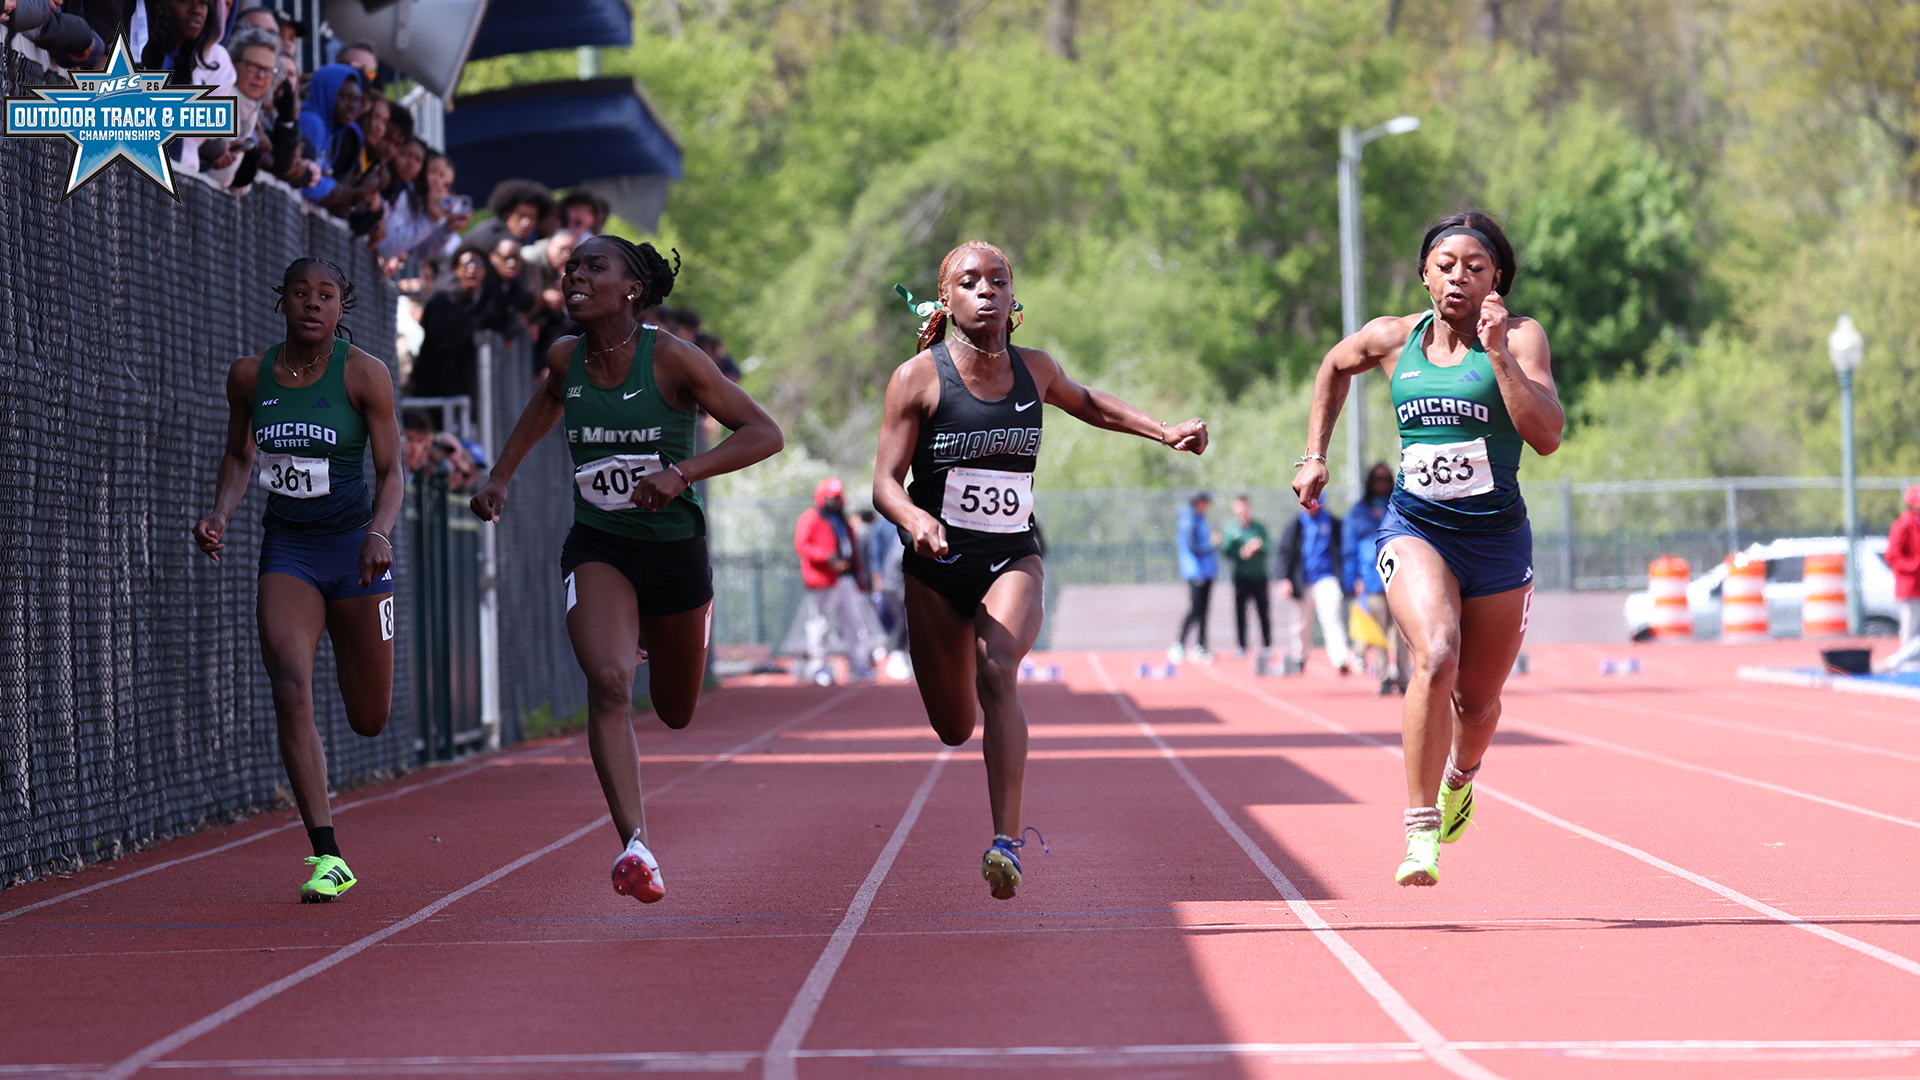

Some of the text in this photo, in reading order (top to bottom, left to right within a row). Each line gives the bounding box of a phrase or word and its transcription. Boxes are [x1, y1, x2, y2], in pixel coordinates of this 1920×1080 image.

[261, 398, 279, 406] NEC
[1397, 398, 1489, 424] CHICAGO
[1421, 415, 1460, 425] STATE
[256, 422, 337, 445] CHICAGO
[274, 438, 310, 448] STATE
[582, 426, 662, 443] MOYNE
[270, 463, 313, 492] 361
[1415, 453, 1474, 486] 363
[960, 484, 1020, 516] 539
[1379, 550, 1395, 584] 5
[384, 600, 393, 636] 8
